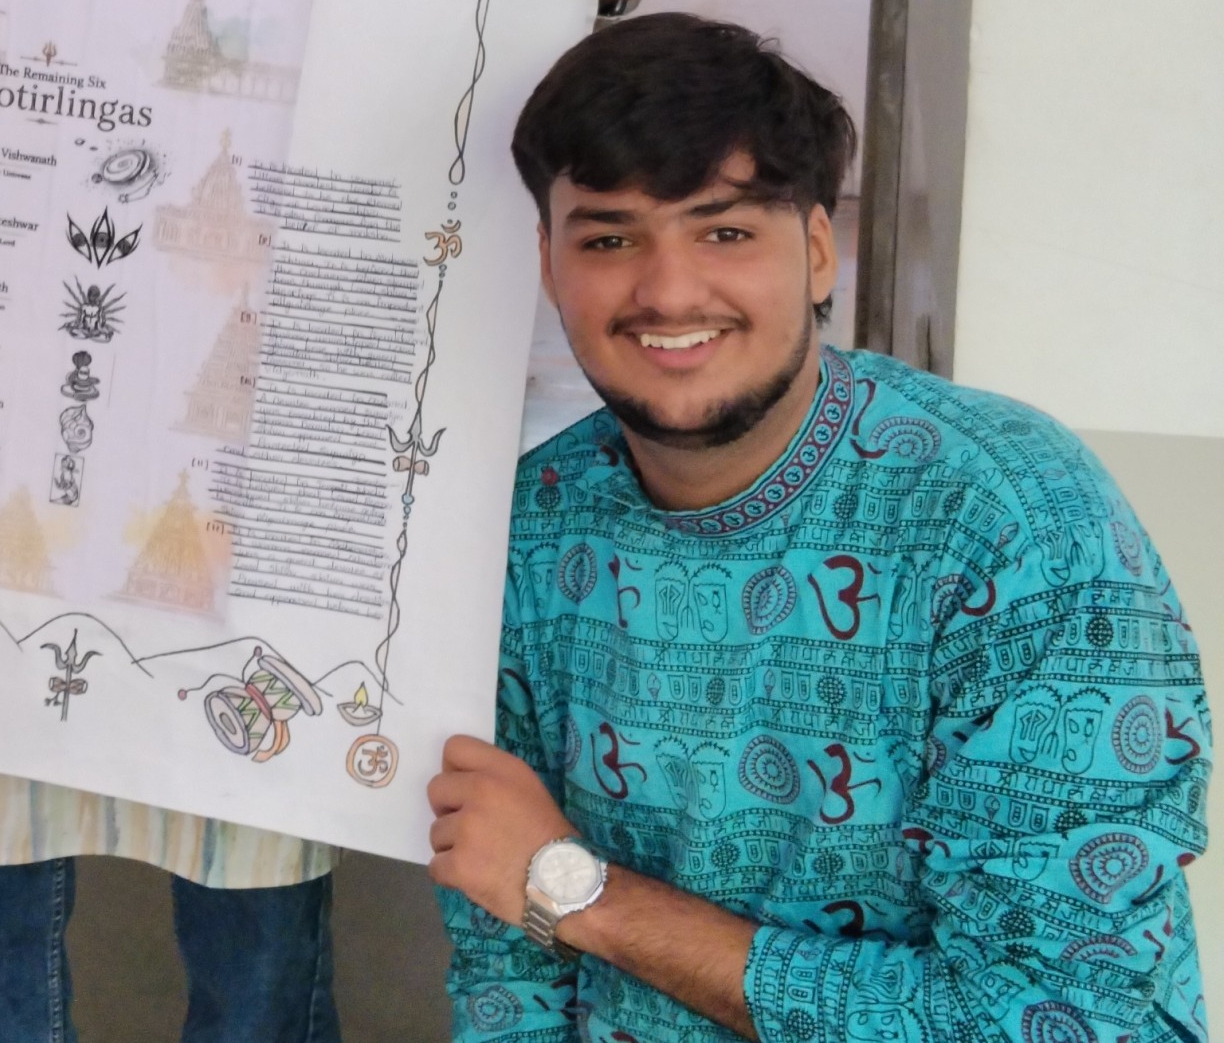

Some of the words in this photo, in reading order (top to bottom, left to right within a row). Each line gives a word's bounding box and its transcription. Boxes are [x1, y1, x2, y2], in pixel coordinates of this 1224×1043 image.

[24, 68, 84, 88] Remaining
[88, 76, 106, 89] Six
[1, 147, 56, 166] Vishwanath
